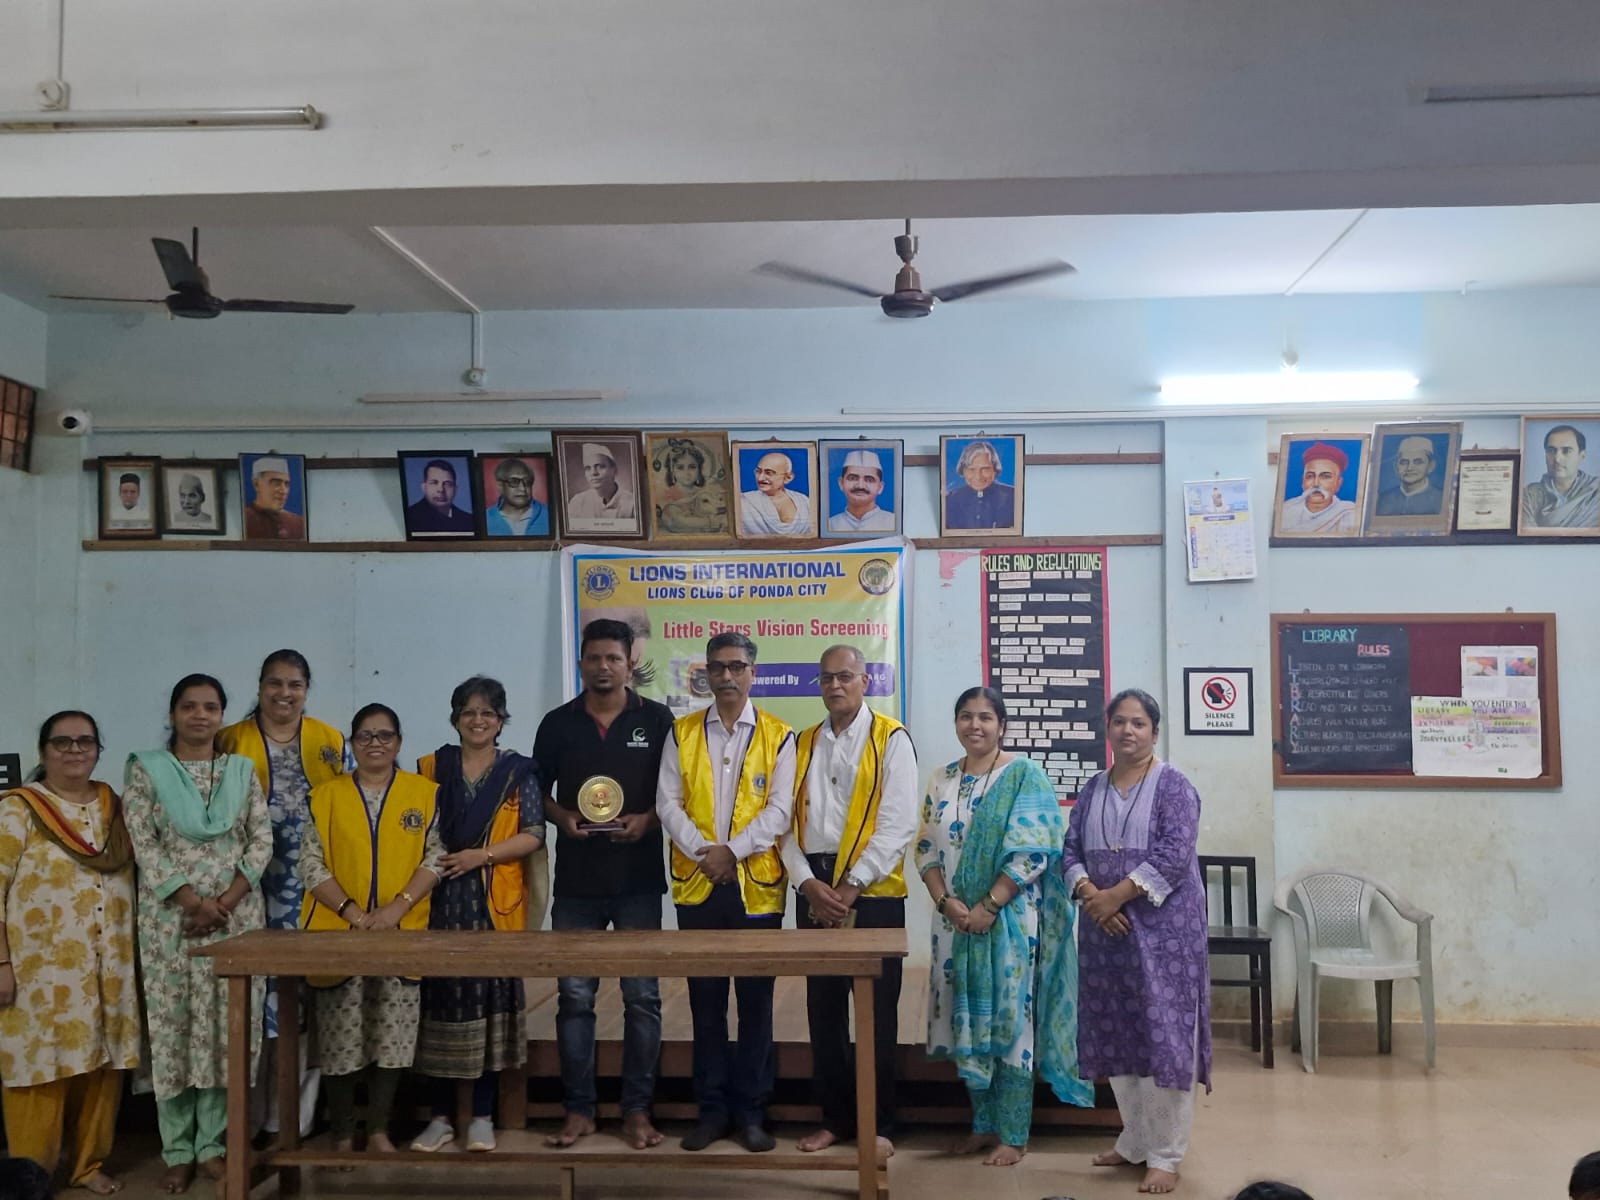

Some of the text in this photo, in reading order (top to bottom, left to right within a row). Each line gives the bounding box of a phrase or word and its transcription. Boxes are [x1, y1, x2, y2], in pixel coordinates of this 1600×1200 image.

[981, 553, 1102, 572] RULES AND REGULATIONS
[629, 565, 687, 582] LIONS
[692, 561, 846, 580] INTERNATIONAL
[647, 583, 827, 599] LIONS CLUB OF PONDA CITY
[663, 618, 888, 640] Little Stars Vision Screening
[1302, 628, 1357, 643] LIBRARY
[1357, 644, 1391, 657] RULES
[787, 674, 800, 686] By
